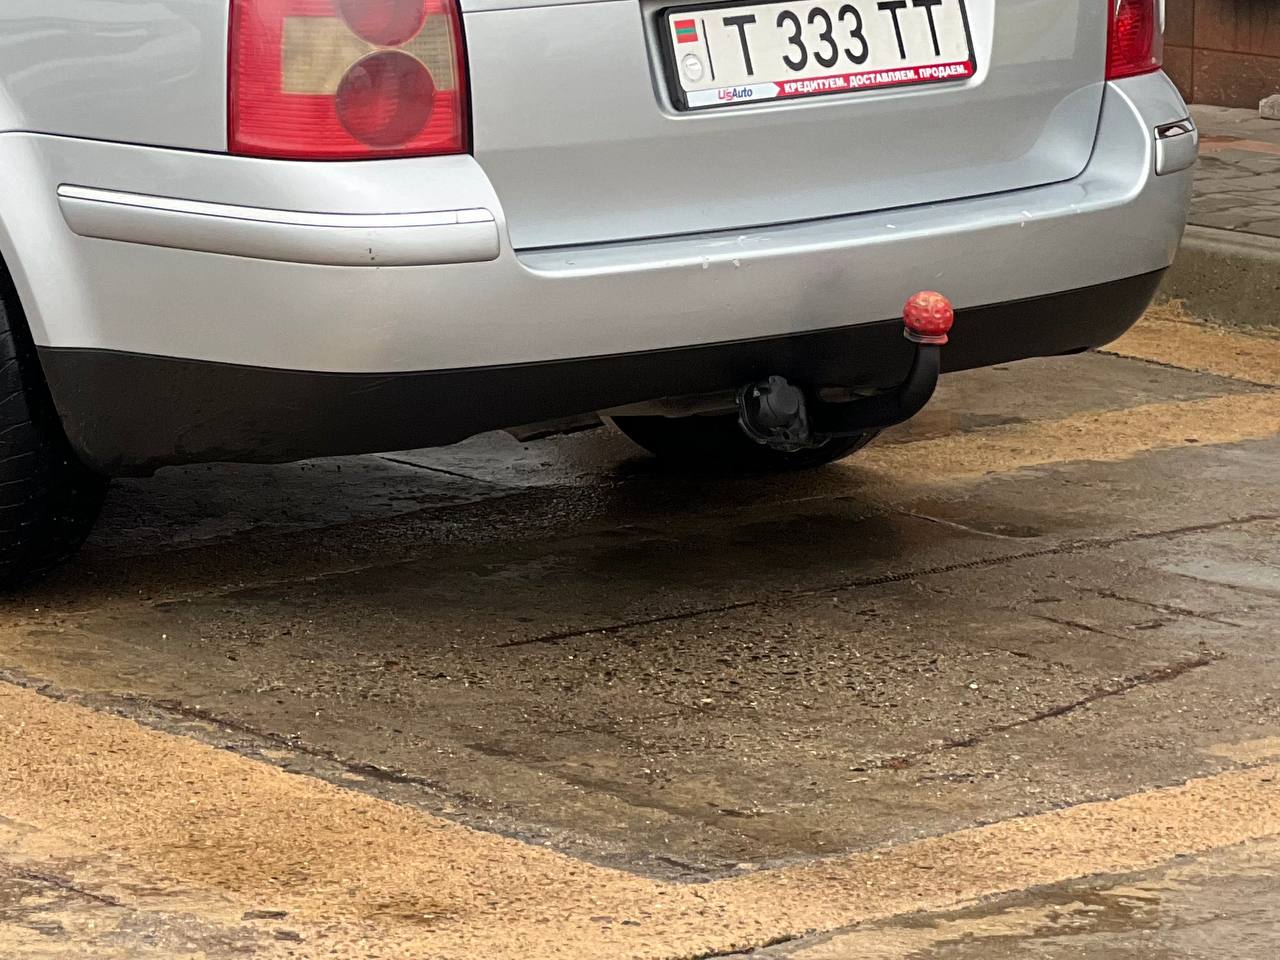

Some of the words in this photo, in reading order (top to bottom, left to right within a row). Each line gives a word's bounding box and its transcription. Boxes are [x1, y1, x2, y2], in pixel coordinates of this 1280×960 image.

[723, 14, 758, 76] T
[776, 4, 869, 72] 333
[784, 77, 847, 94] КРЕДИТУЕМ.
[849, 68, 918, 88] ДОСТАВЛЯЕМ.
[919, 64, 968, 79] ПРОДАЕМ.
